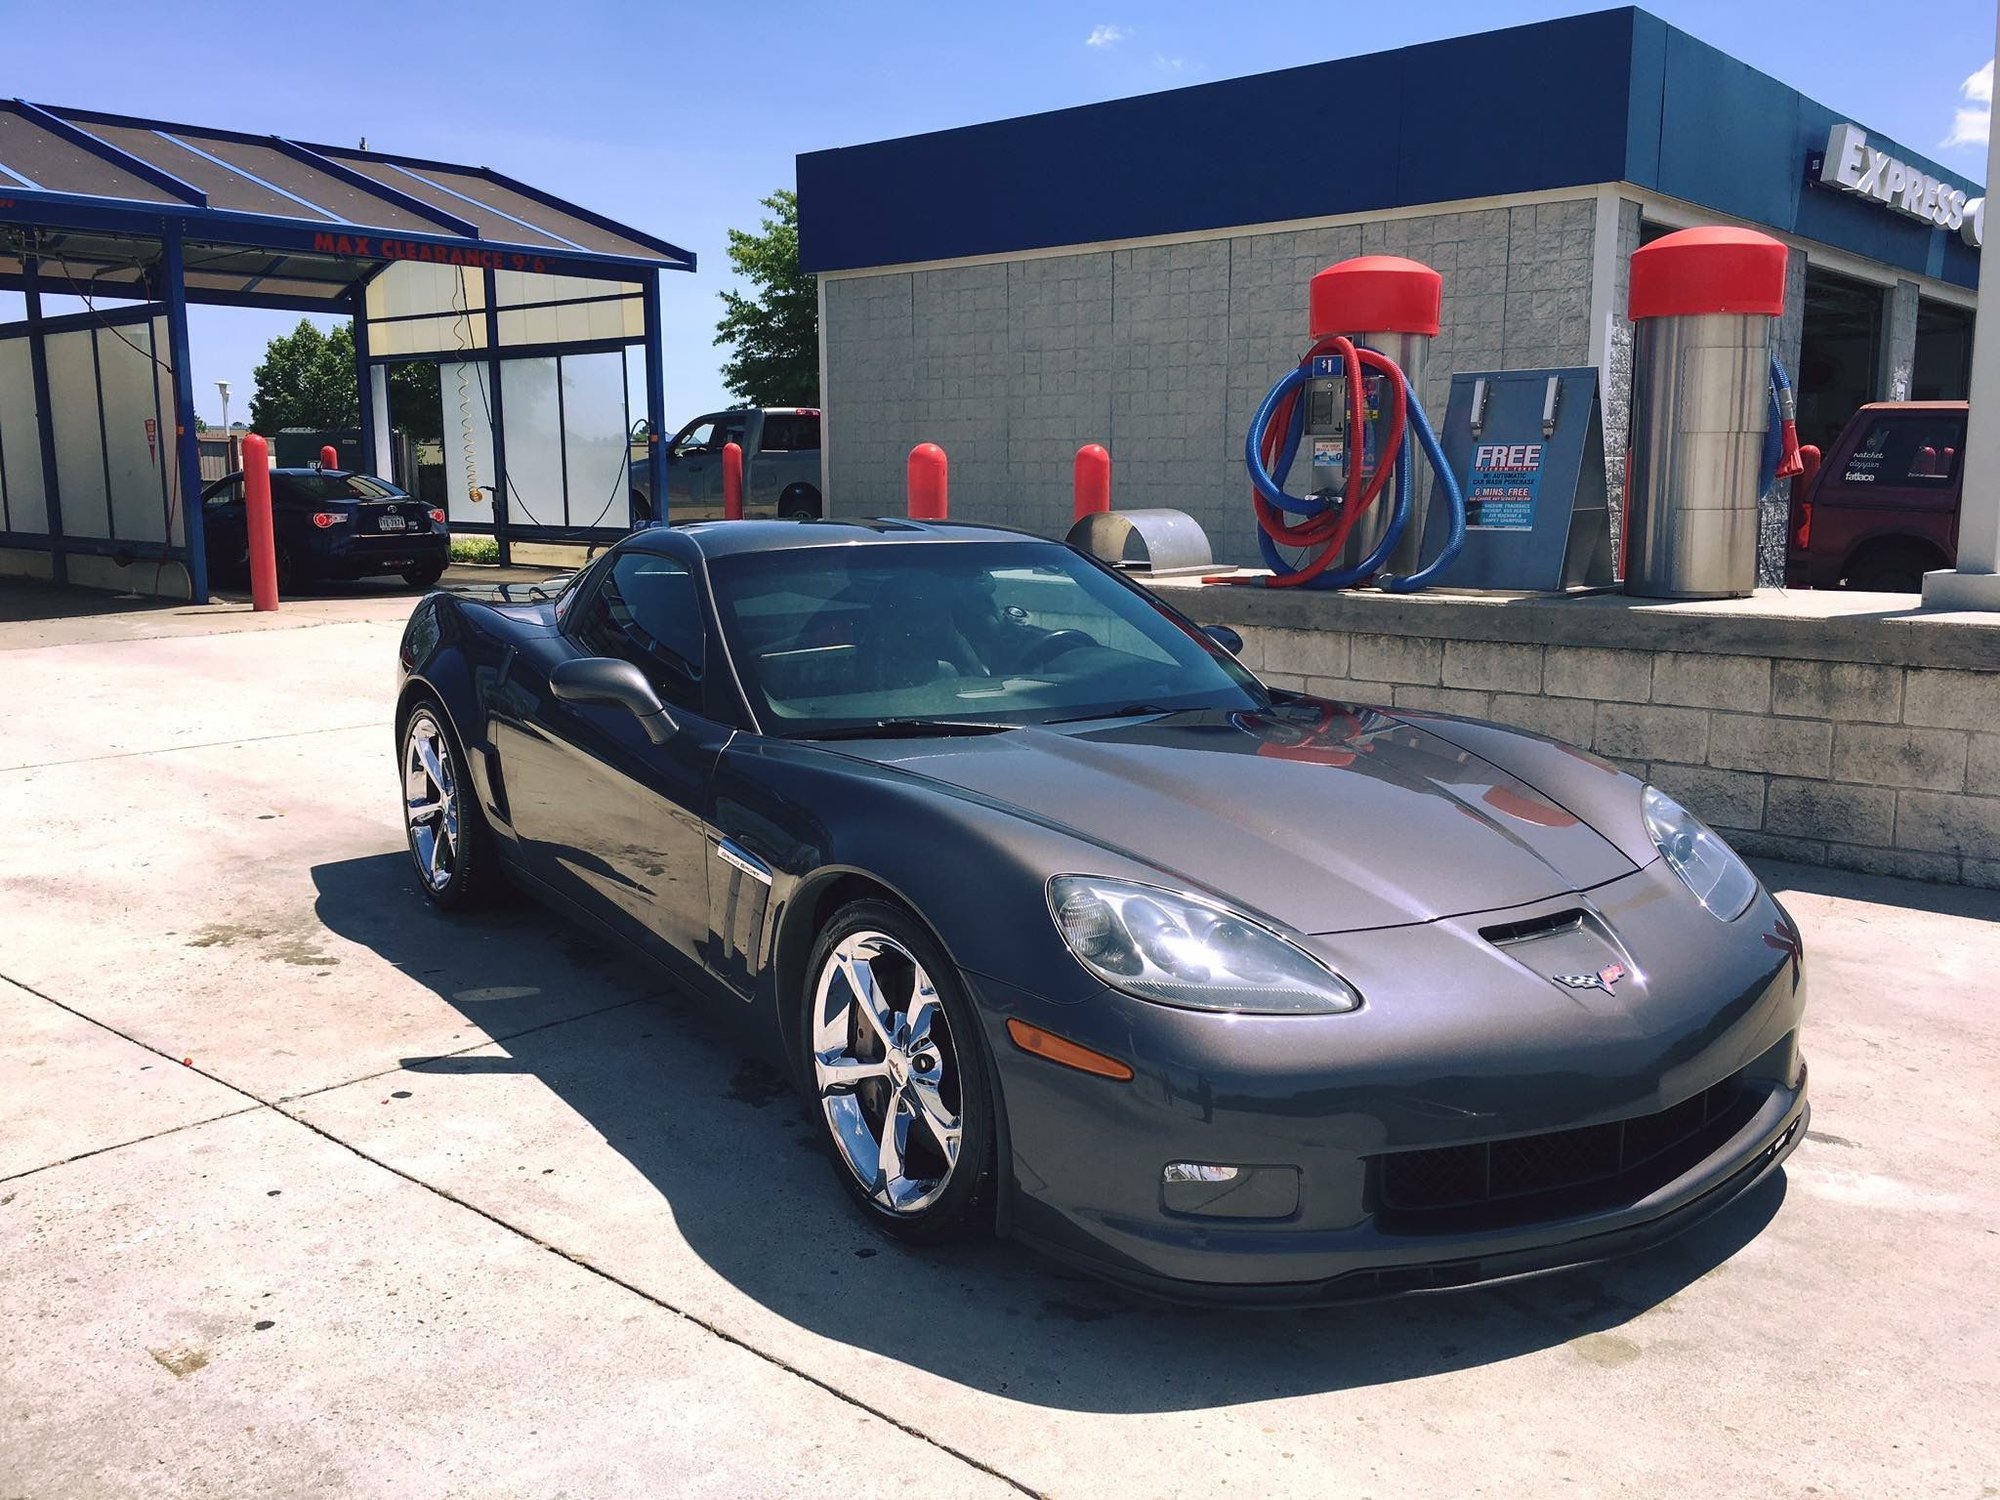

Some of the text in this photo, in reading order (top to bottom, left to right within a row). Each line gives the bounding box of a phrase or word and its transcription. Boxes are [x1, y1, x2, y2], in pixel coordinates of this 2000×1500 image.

[1821, 123, 1966, 230] EXPRESS
[313, 233, 370, 255] MAX
[381, 240, 504, 269] CLEARANCE
[1321, 359, 1333, 373] $1
[1475, 445, 1541, 467] FREE
[1474, 487, 1480, 496] 6
[1507, 487, 1529, 496] FREE
